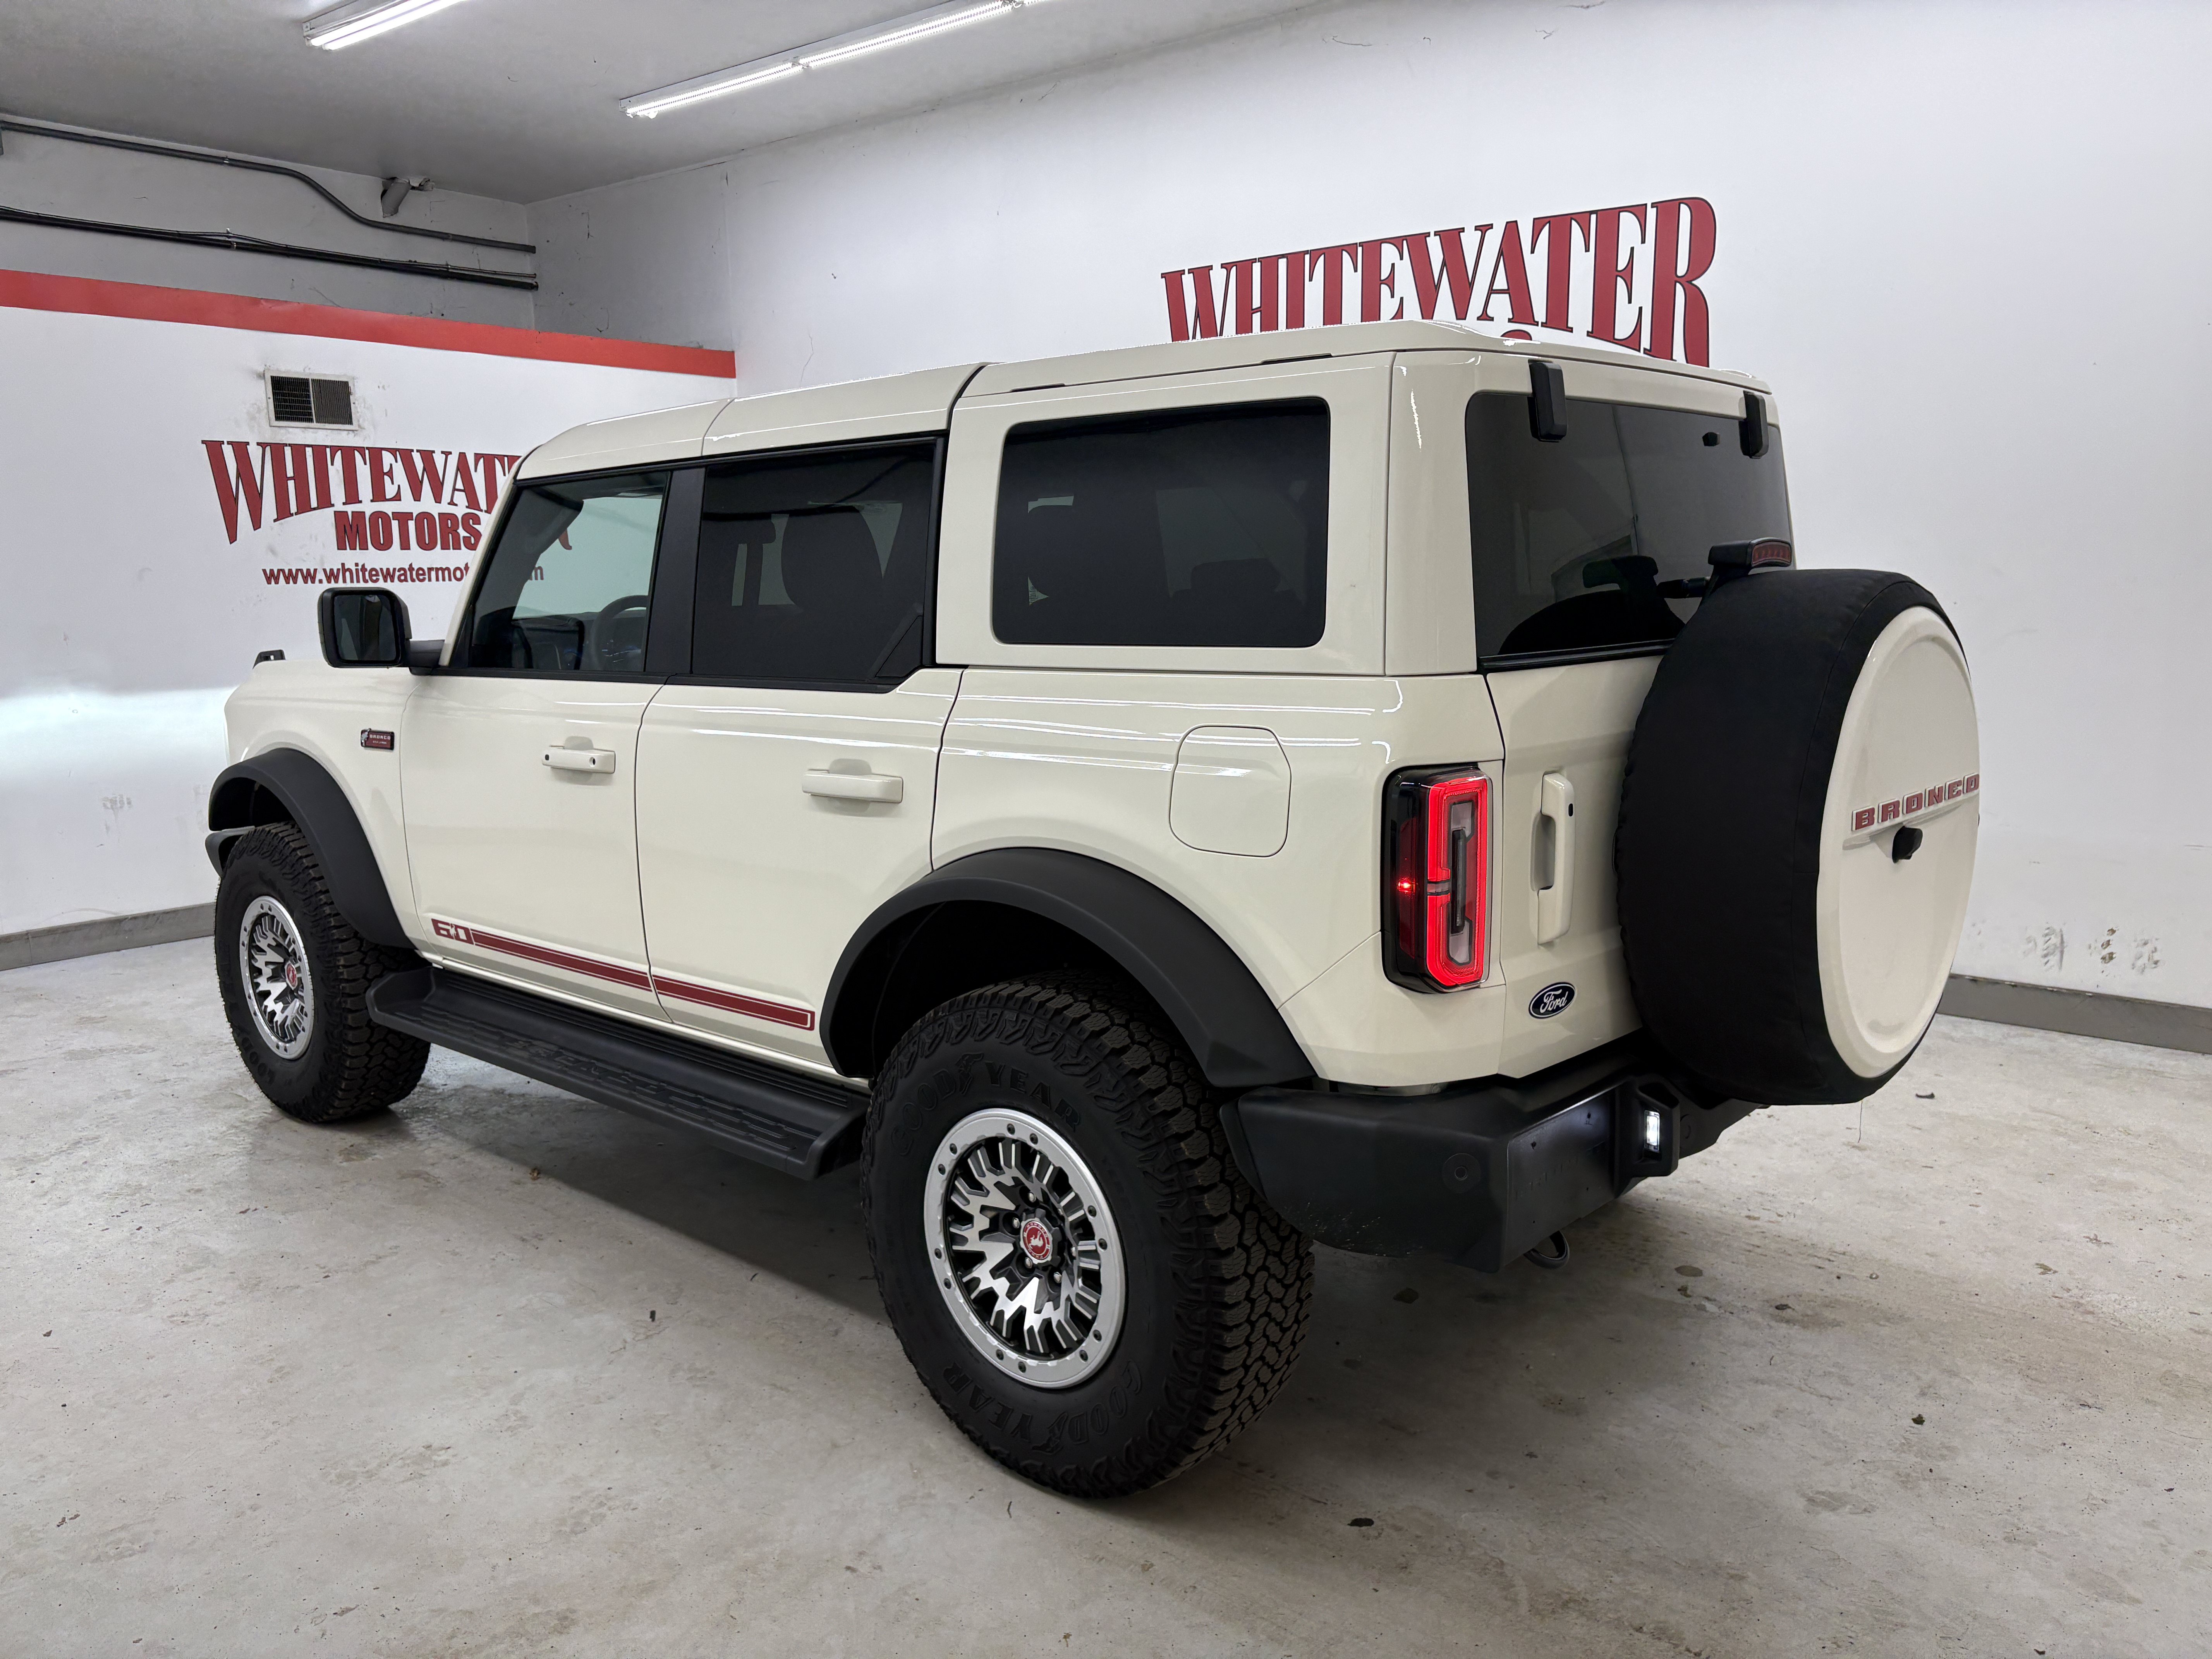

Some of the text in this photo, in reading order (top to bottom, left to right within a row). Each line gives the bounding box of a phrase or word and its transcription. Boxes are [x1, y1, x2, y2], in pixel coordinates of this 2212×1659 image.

[1161, 196, 1716, 367] WHITEWATER
[201, 440, 572, 550] WHITEWAT
[333, 510, 482, 551] MOTORS
[1851, 772, 1980, 831] BRONCO
[1539, 989, 1569, 1013] Ford
